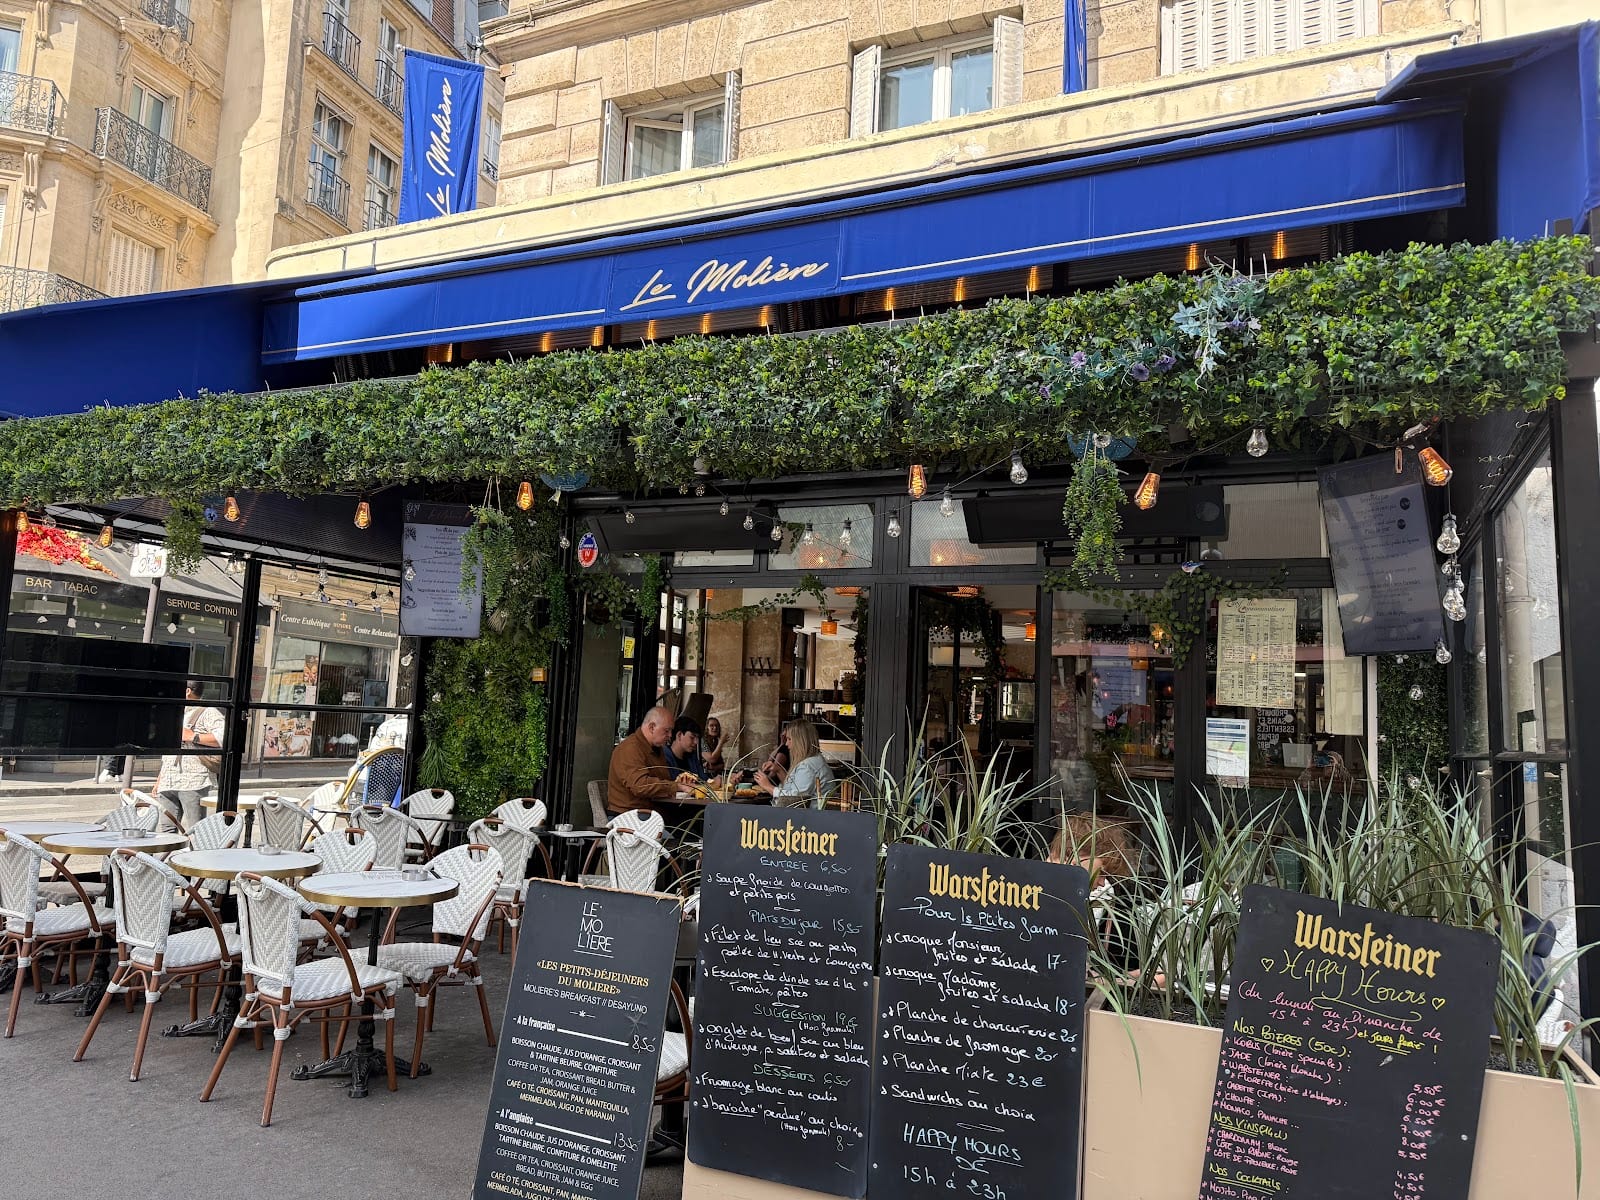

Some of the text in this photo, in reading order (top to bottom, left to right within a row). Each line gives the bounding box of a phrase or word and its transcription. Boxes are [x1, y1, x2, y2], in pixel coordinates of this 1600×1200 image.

[426, 183, 451, 217] Le
[619, 255, 829, 311] Le Molière
[25, 577, 98, 595] BAR TABAC
[166, 597, 238, 617] SERVICE CONTINU
[280, 614, 301, 624] Centre
[353, 626, 371, 635] Centre
[740, 817, 839, 857] Warsteiner
[729, 887, 741, 897] et
[790, 878, 803, 888] de
[928, 862, 1044, 911] Warsteiner
[583, 901, 600, 917] LE
[898, 896, 957, 921] Pour
[580, 917, 603, 934] MO
[744, 929, 759, 942] de
[1294, 909, 1442, 980] Warsteiner
[973, 954, 988, 965] et
[991, 956, 1039, 973] salade
[558, 975, 572, 986] DU
[560, 963, 649, 987] PETITS-DÉJEUNERS
[763, 970, 778, 981] de
[523, 983, 648, 1014] MOLIERE'S BREAKFAST DESAYUNO
[982, 992, 999, 1002] et
[1002, 994, 1052, 1013] salade
[522, 1016, 527, 1026] la
[528, 1018, 556, 1031] française
[897, 1001, 949, 1023] Planche
[953, 1011, 969, 1026] de
[1302, 1018, 1310, 1026] à
[1323, 1007, 1342, 1019] au
[1422, 1026, 1444, 1042] de
[1357, 1029, 1368, 1040] et
[893, 1024, 947, 1045] Planche
[945, 1034, 962, 1048] de
[511, 1036, 540, 1049] BOISSON
[537, 1042, 563, 1055] CHAUDE,
[563, 1047, 574, 1057] JUS
[607, 1057, 642, 1072] CROISSANT
[535, 1051, 559, 1064] TARTINE
[584, 1062, 618, 1077] CONFITURE
[893, 1052, 951, 1075] Planche
[507, 1058, 529, 1071] COFFEE
[529, 1063, 539, 1072] OR
[607, 1081, 630, 1094] BUTTER
[506, 1079, 521, 1089] CAFÉ
[521, 1082, 527, 1090] O
[585, 1097, 630, 1116] MANTEQUILLA,
[555, 1079, 580, 1092] ORANGE
[580, 1085, 598, 1097] JUICE
[557, 1101, 575, 1112] JUGO
[575, 1105, 584, 1115] DE
[967, 1100, 989, 1110] au
[903, 1123, 1022, 1161] HAPPY HOURS
[586, 1156, 618, 1172] OMELETTE
[560, 1176, 574, 1186] JAM
[580, 1182, 594, 1191] EGG
[903, 1165, 1007, 1200] 15h à 23h
